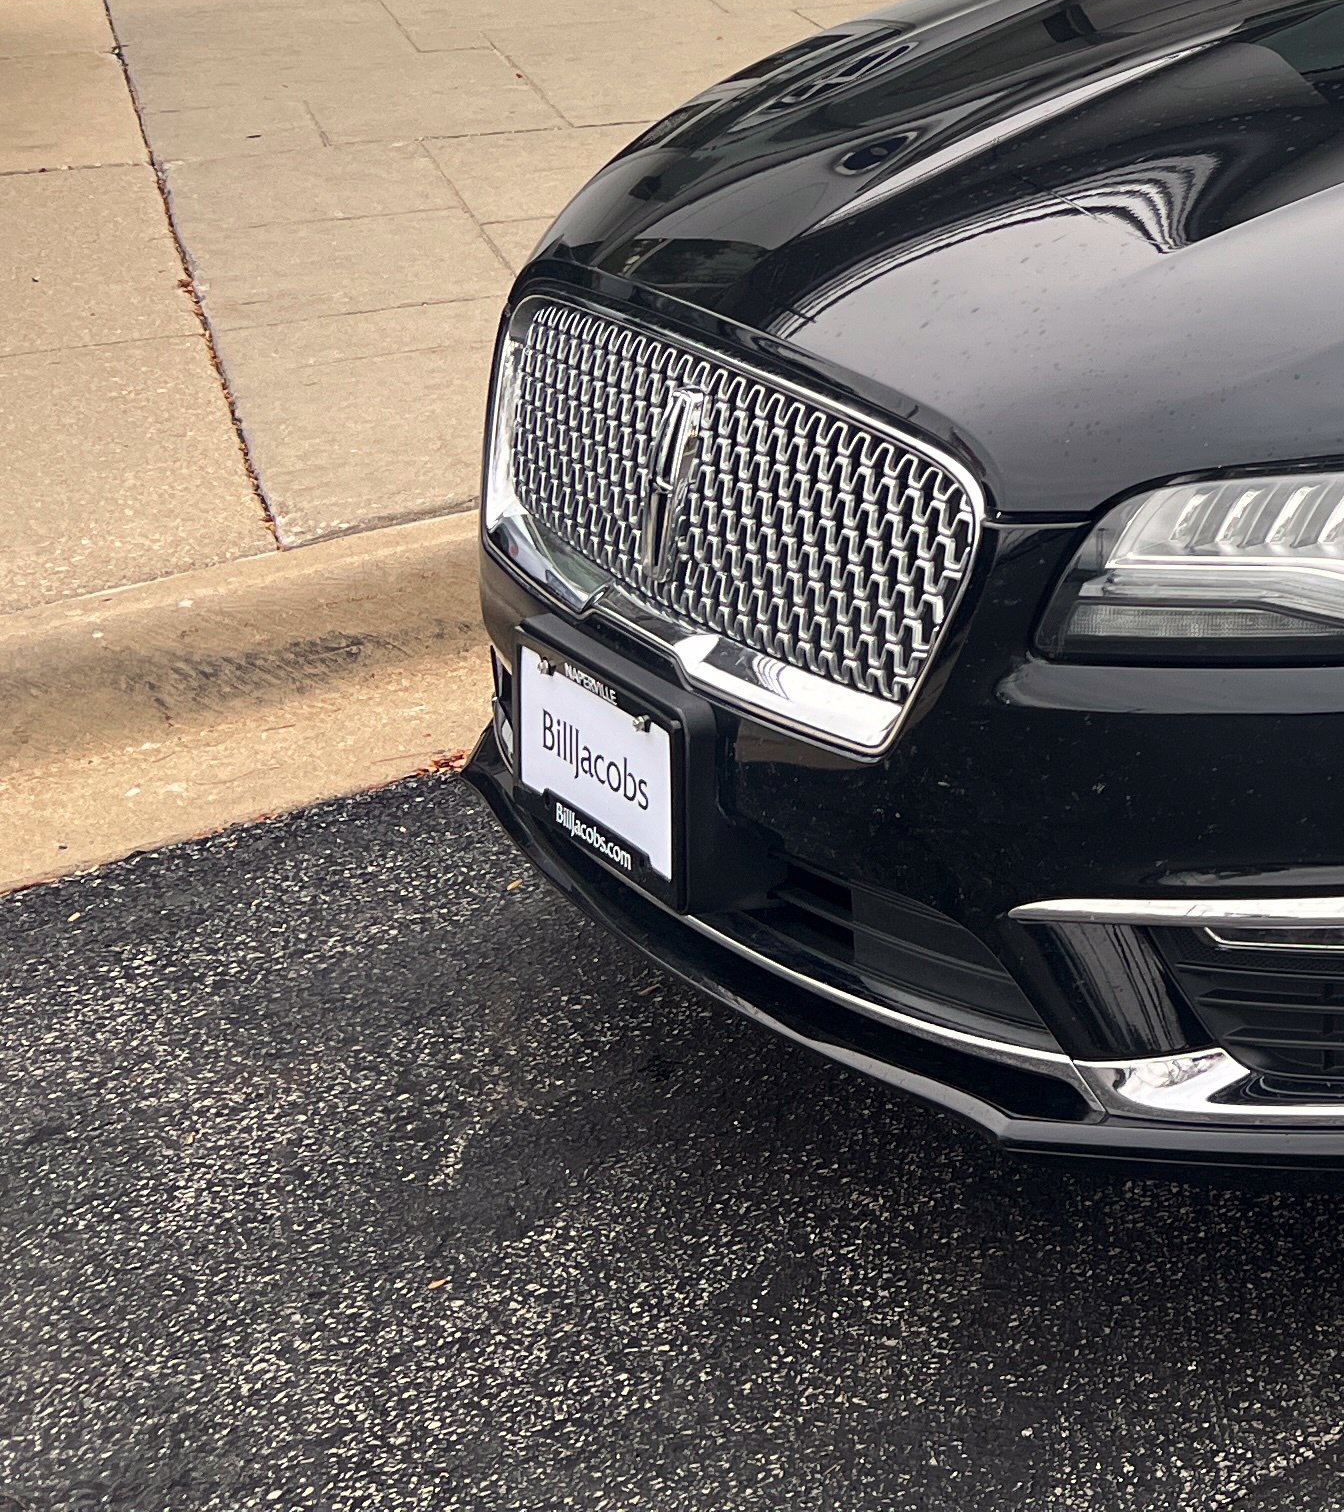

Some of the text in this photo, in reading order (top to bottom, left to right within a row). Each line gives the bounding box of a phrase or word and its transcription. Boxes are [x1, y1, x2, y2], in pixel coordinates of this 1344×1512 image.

[564, 662, 618, 706] NAPERVILLE
[542, 707, 649, 811] BillJacobs
[556, 801, 632, 871] BillJacobs.com
